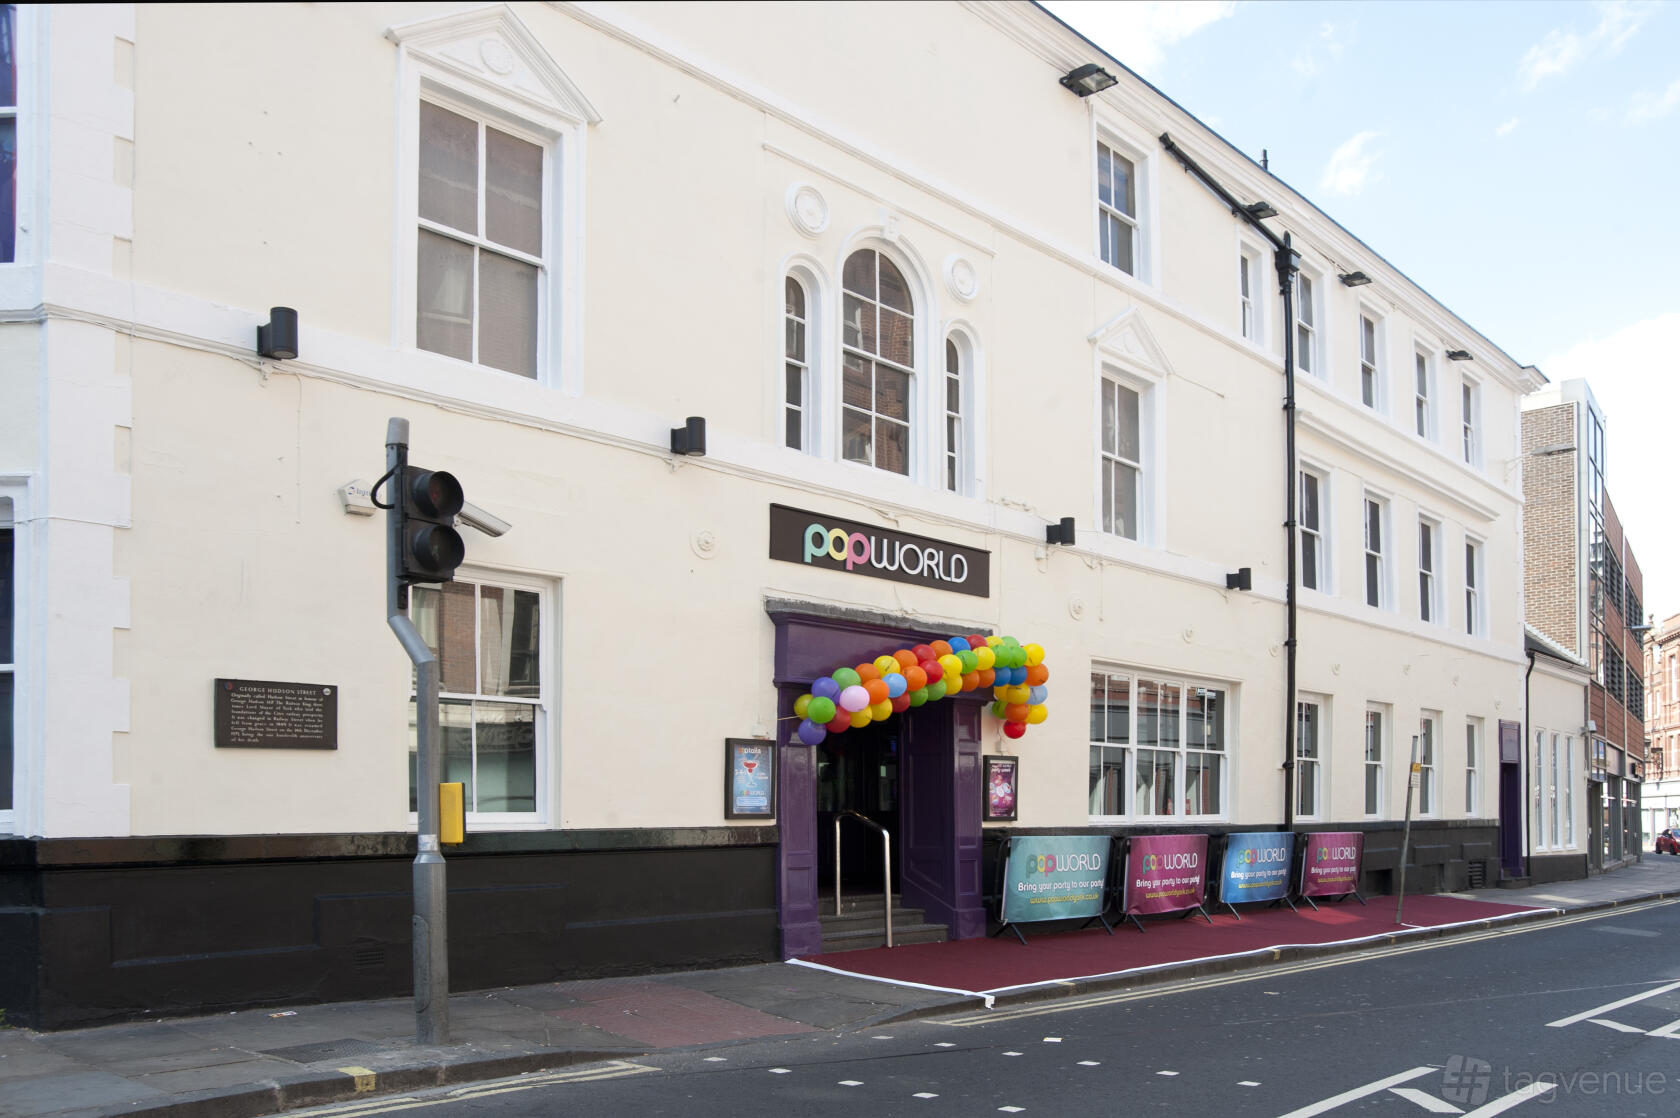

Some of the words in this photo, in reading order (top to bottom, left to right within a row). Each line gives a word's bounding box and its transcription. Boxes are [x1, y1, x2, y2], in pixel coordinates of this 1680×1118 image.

[1018, 883, 1037, 892] Bring
[1038, 883, 1051, 892] your
[1054, 882, 1071, 891] party
[1136, 879, 1151, 888] Bring
[1152, 880, 1161, 888] your
[1162, 878, 1175, 886] party
